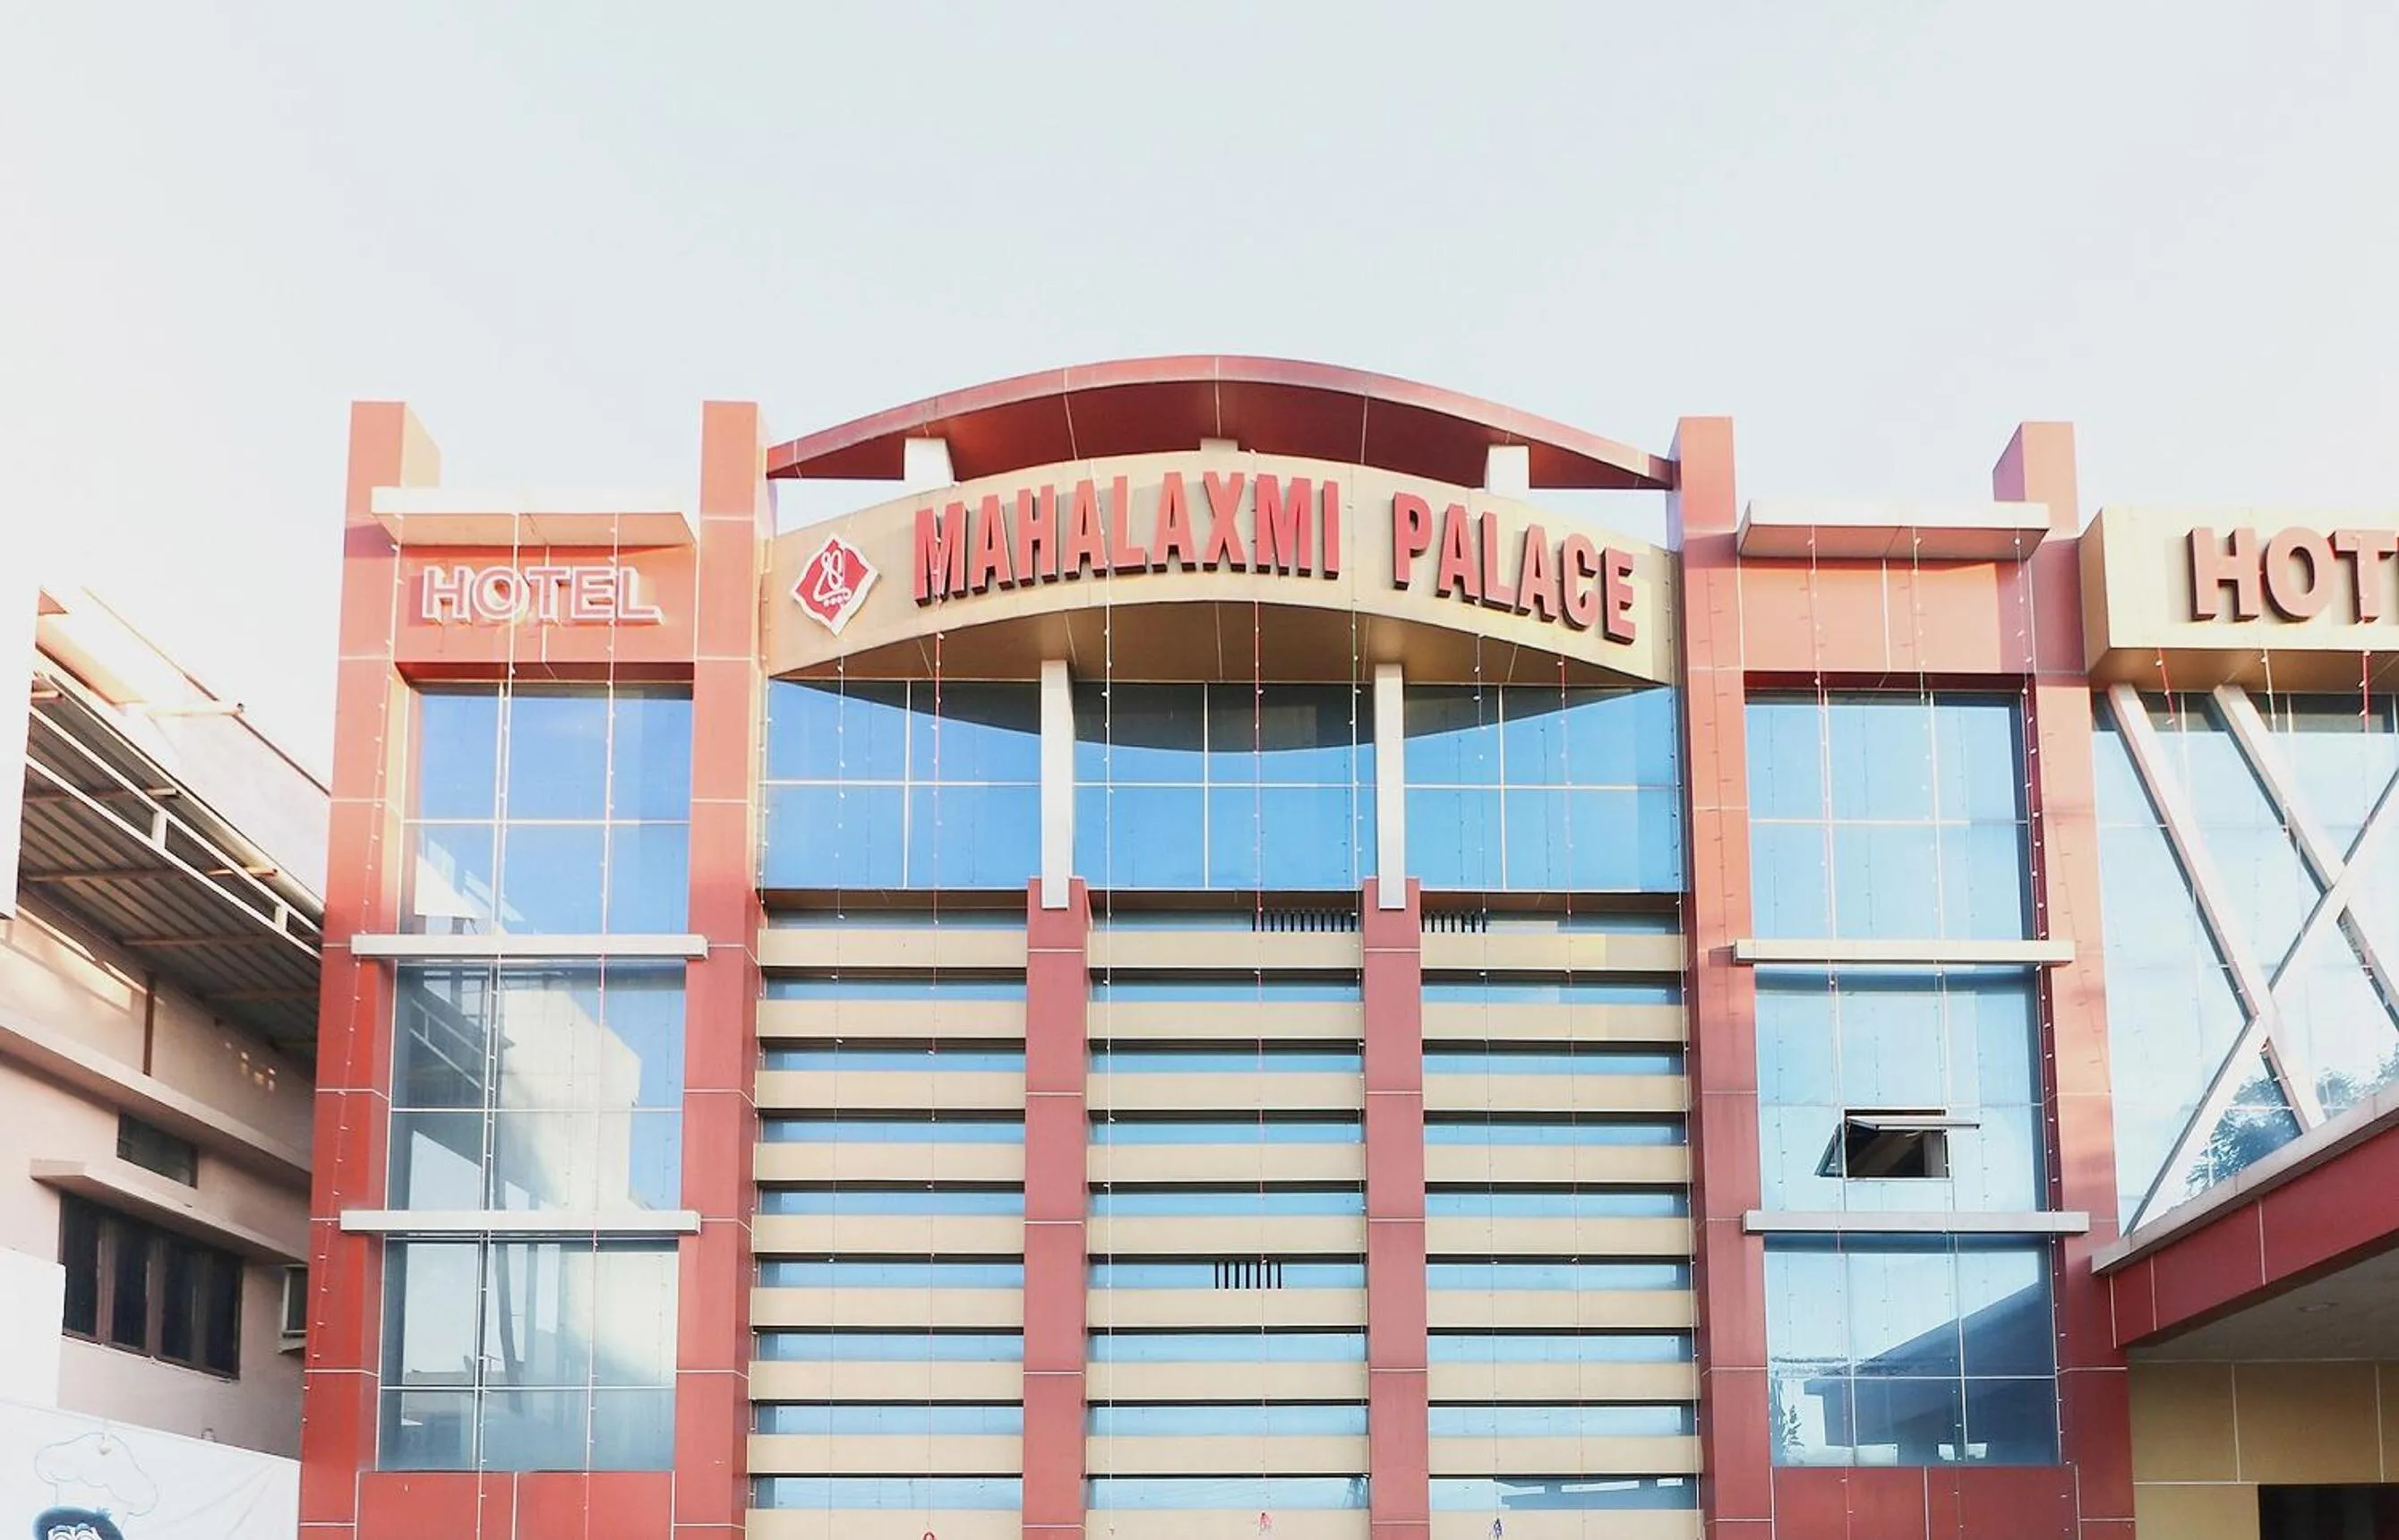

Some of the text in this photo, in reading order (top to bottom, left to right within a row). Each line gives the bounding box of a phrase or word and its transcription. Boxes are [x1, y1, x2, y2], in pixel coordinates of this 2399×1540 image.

[417, 565, 664, 625] HOTEL
[913, 472, 1636, 645] MAHALAXMI PALACE
[2186, 526, 2399, 624] HOT
